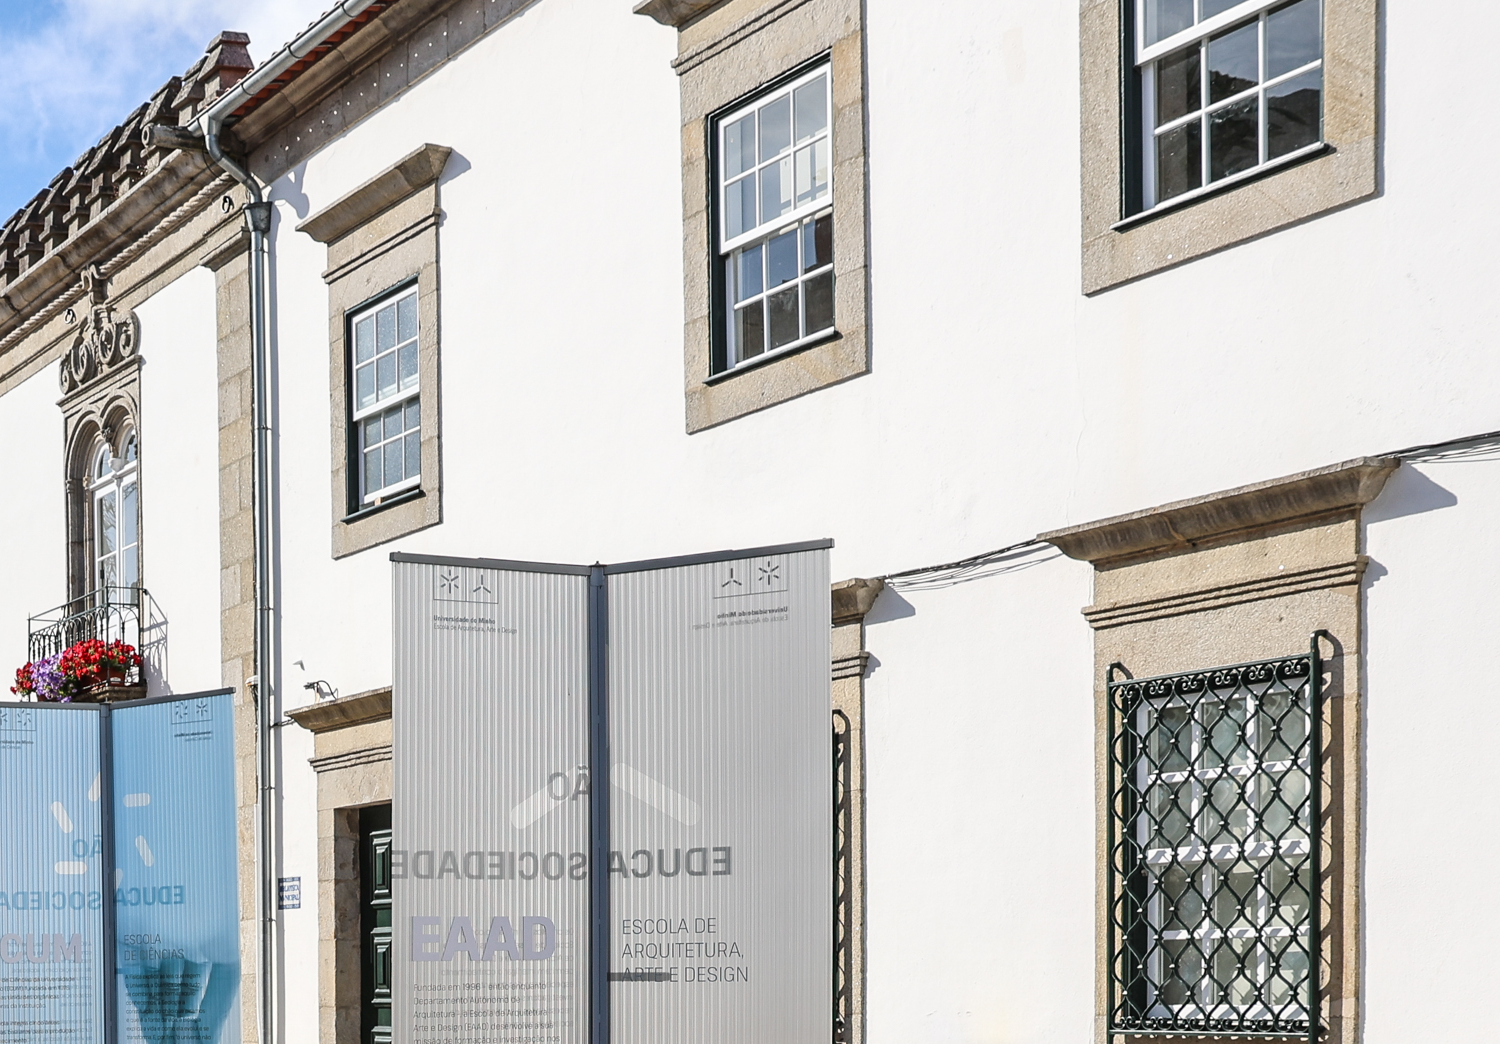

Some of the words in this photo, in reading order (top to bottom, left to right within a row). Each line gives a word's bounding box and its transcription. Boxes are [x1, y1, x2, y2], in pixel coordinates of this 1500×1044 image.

[622, 918, 689, 935] ESCOLA
[695, 917, 717, 934] DE
[124, 934, 162, 945] ESCOLA
[411, 916, 556, 962] EAAD
[124, 950, 137, 961] DE
[621, 941, 744, 960] ARQUITETURA,
[621, 966, 664, 983] ARTE
[669, 967, 679, 983] E
[685, 966, 749, 983] DESIGN
[413, 983, 446, 992] Fundada
[413, 997, 468, 1006] Departamento
[413, 1024, 429, 1032] Arte
[437, 1023, 463, 1033] Design
[464, 1022, 489, 1032] (EAAD)
[442, 1037, 453, 1044] de
[499, 1035, 545, 1044] investigação
[546, 1035, 561, 1043] nos
